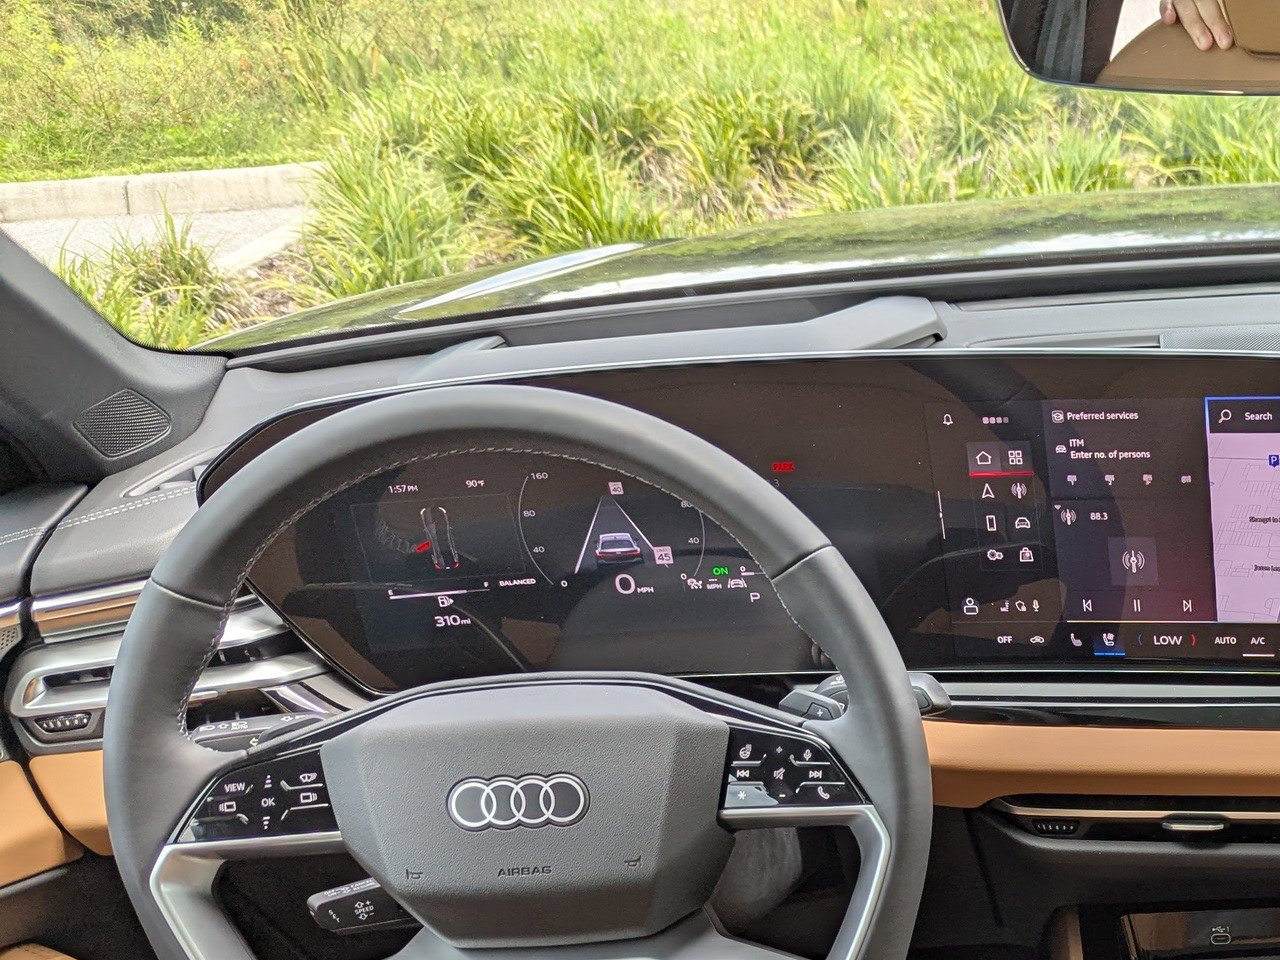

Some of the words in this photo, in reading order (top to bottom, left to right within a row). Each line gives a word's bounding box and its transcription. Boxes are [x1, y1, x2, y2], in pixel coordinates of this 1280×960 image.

[1067, 411, 1105, 421] Preferred
[1106, 411, 1139, 421] services
[1244, 411, 1273, 421] Search
[1069, 438, 1085, 448] ITM
[1070, 450, 1092, 459] Enter
[1094, 451, 1107, 459] no.
[1108, 449, 1118, 459] of
[1118, 451, 1151, 461] persons
[772, 462, 795, 472] PARK
[531, 471, 549, 480] 160
[523, 509, 536, 517] 80
[1090, 512, 1109, 521] 88.3
[533, 545, 545, 554] 40
[657, 553, 671, 562] 45
[712, 566, 729, 576] ON
[499, 578, 537, 587] BALANCED
[561, 580, 568, 588] 0
[615, 573, 636, 595] 0
[637, 586, 654, 594] MPH
[750, 592, 761, 603] P
[997, 635, 1013, 645] OFF
[1153, 635, 1183, 646] LOW
[1214, 637, 1237, 645] AUTO
[1250, 637, 1266, 646] A/C
[224, 782, 246, 793] VIEW
[261, 797, 276, 808] OK
[497, 865, 553, 878] AIRBAG
[354, 905, 375, 915] SPEED
